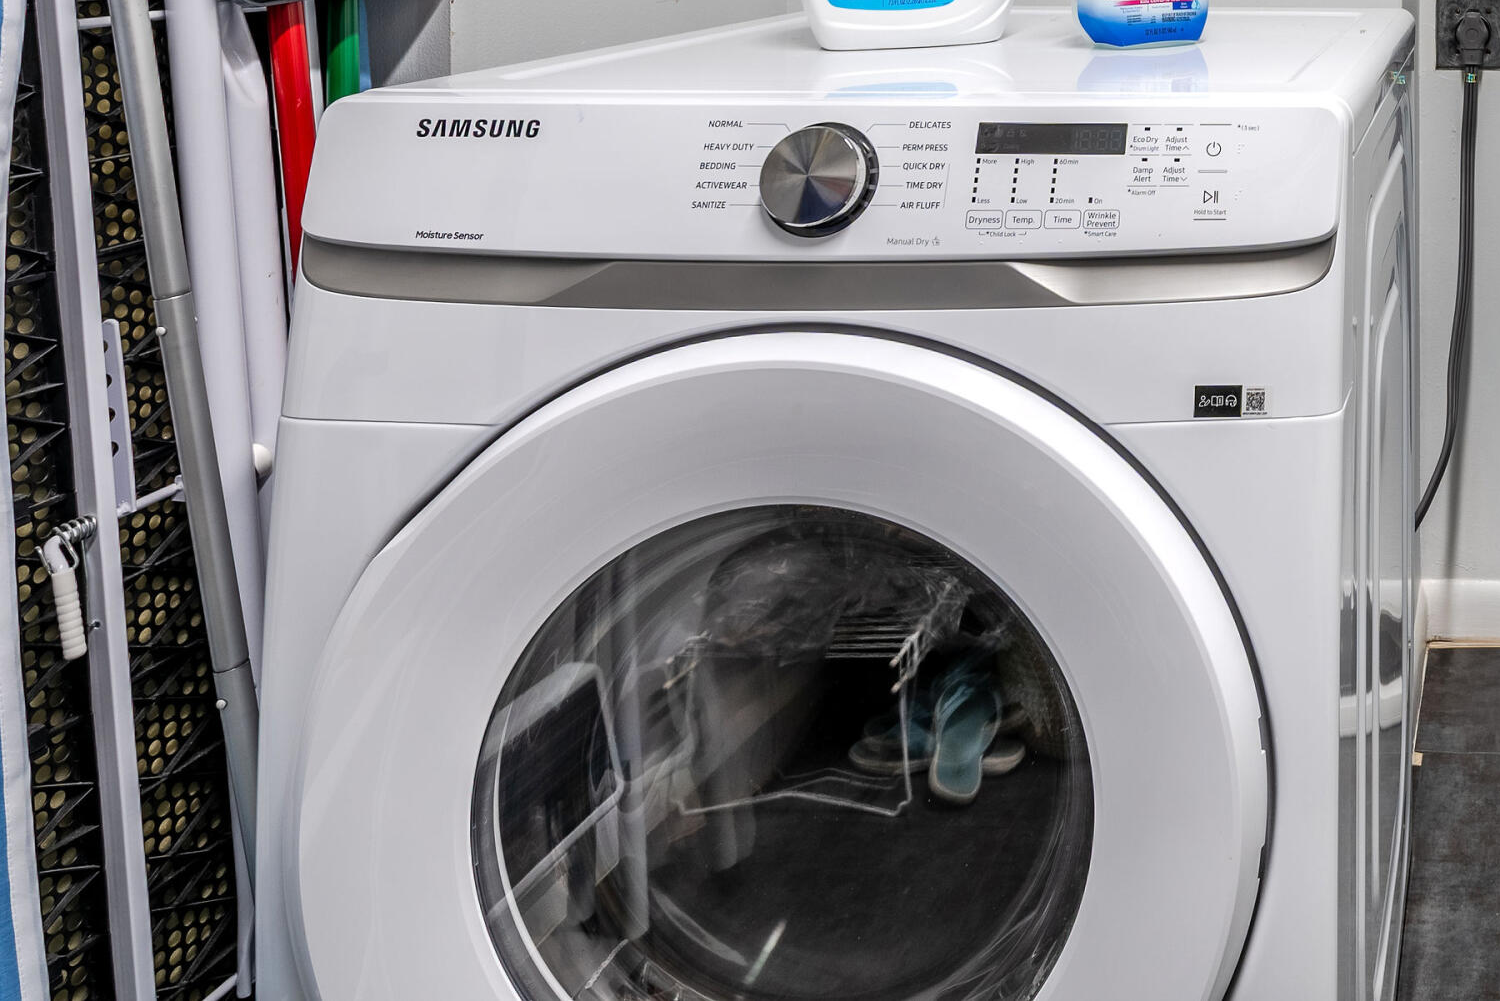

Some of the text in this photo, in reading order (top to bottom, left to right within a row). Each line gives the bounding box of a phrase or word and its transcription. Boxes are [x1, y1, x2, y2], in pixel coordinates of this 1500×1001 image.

[416, 118, 541, 138] SAMSUNG
[708, 120, 744, 128] NORMAL
[1146, 136, 1158, 144] Dry
[1166, 136, 1188, 144] Adjust
[704, 143, 754, 151] HEAVY DUTY
[925, 144, 948, 152] PRESS
[902, 162, 927, 170] QUICK
[1132, 167, 1154, 175] Damp
[1163, 167, 1186, 175] Adjust
[900, 202, 940, 210] AIR FLUFF
[968, 216, 1000, 224] Dryness
[1012, 216, 1034, 224] Temp.
[415, 230, 484, 240] Moisture Sensor
[886, 238, 930, 248] Manual Dry
